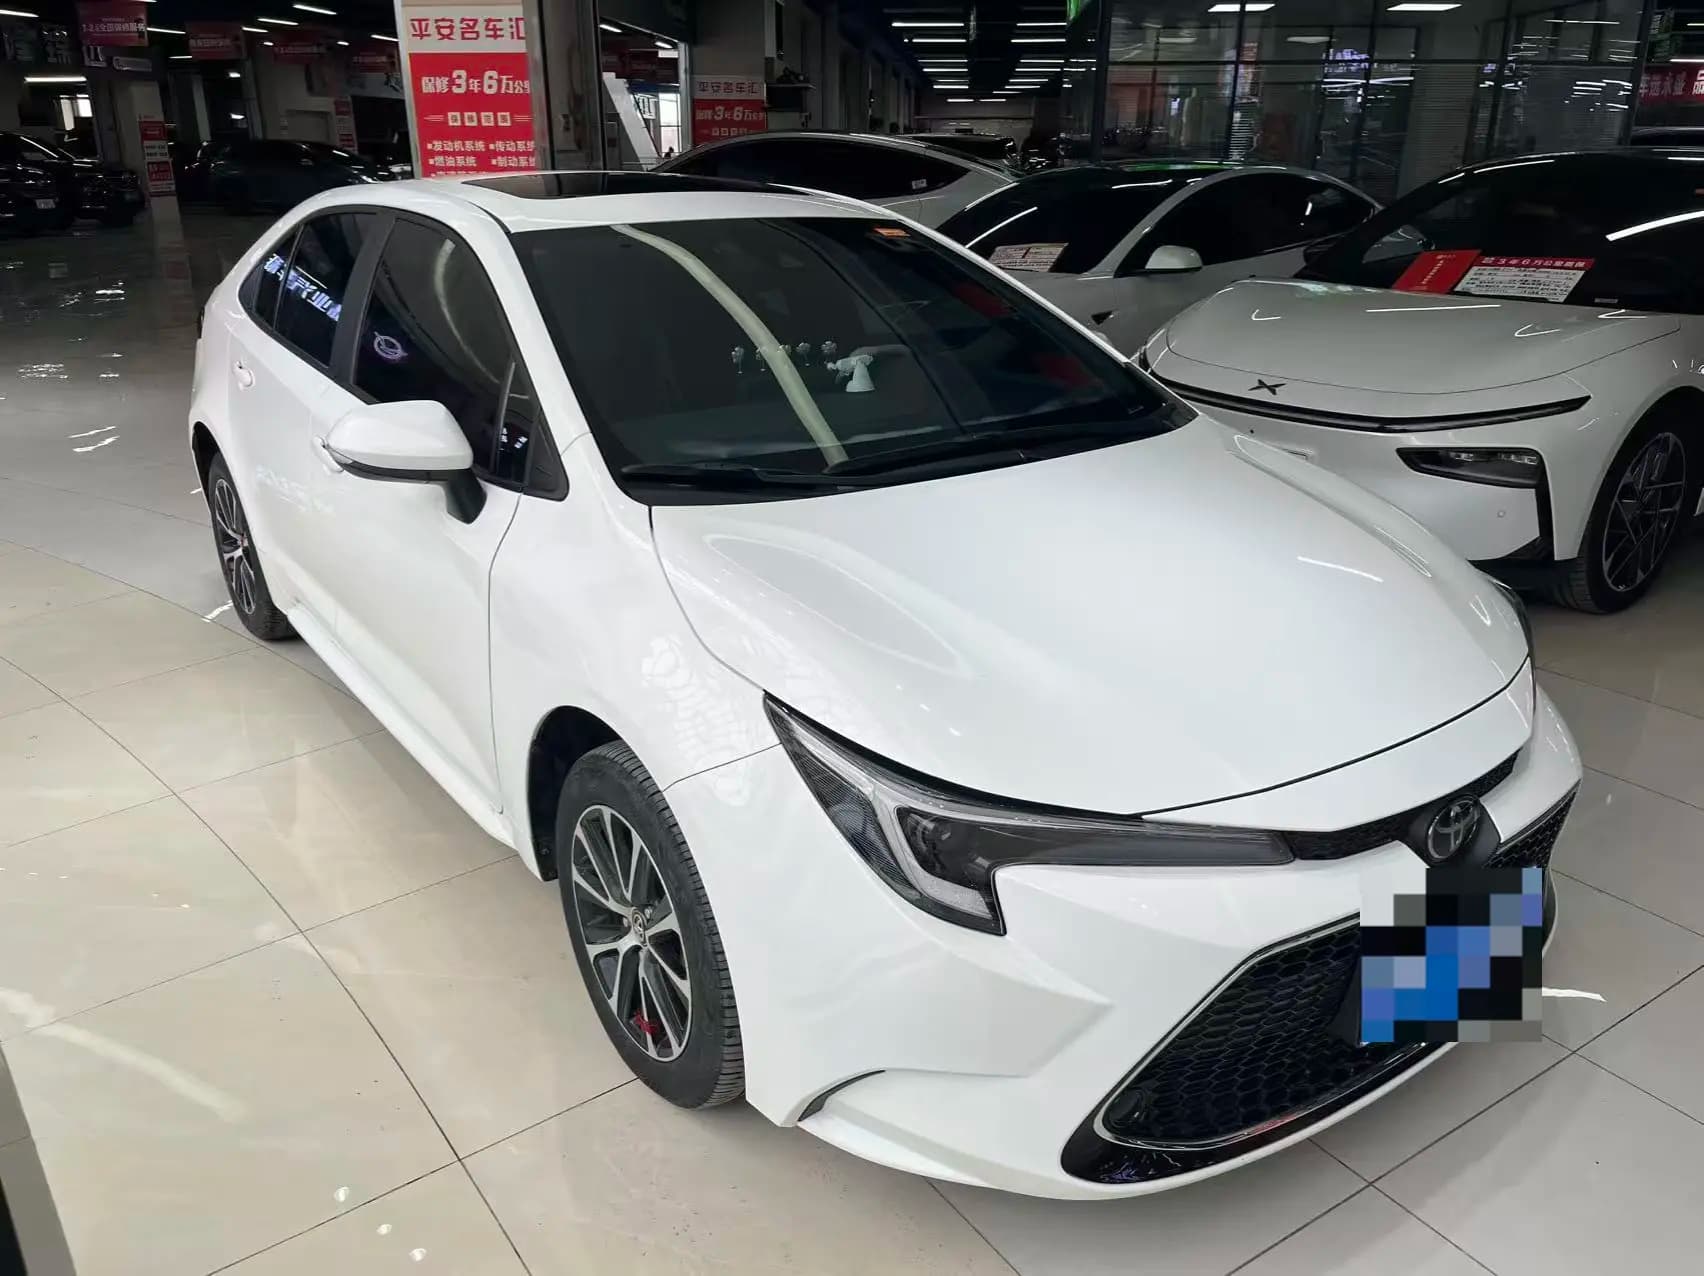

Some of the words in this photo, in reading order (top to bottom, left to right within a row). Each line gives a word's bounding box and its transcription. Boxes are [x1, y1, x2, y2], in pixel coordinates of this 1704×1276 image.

[410, 17, 526, 41] 平安名车汇
